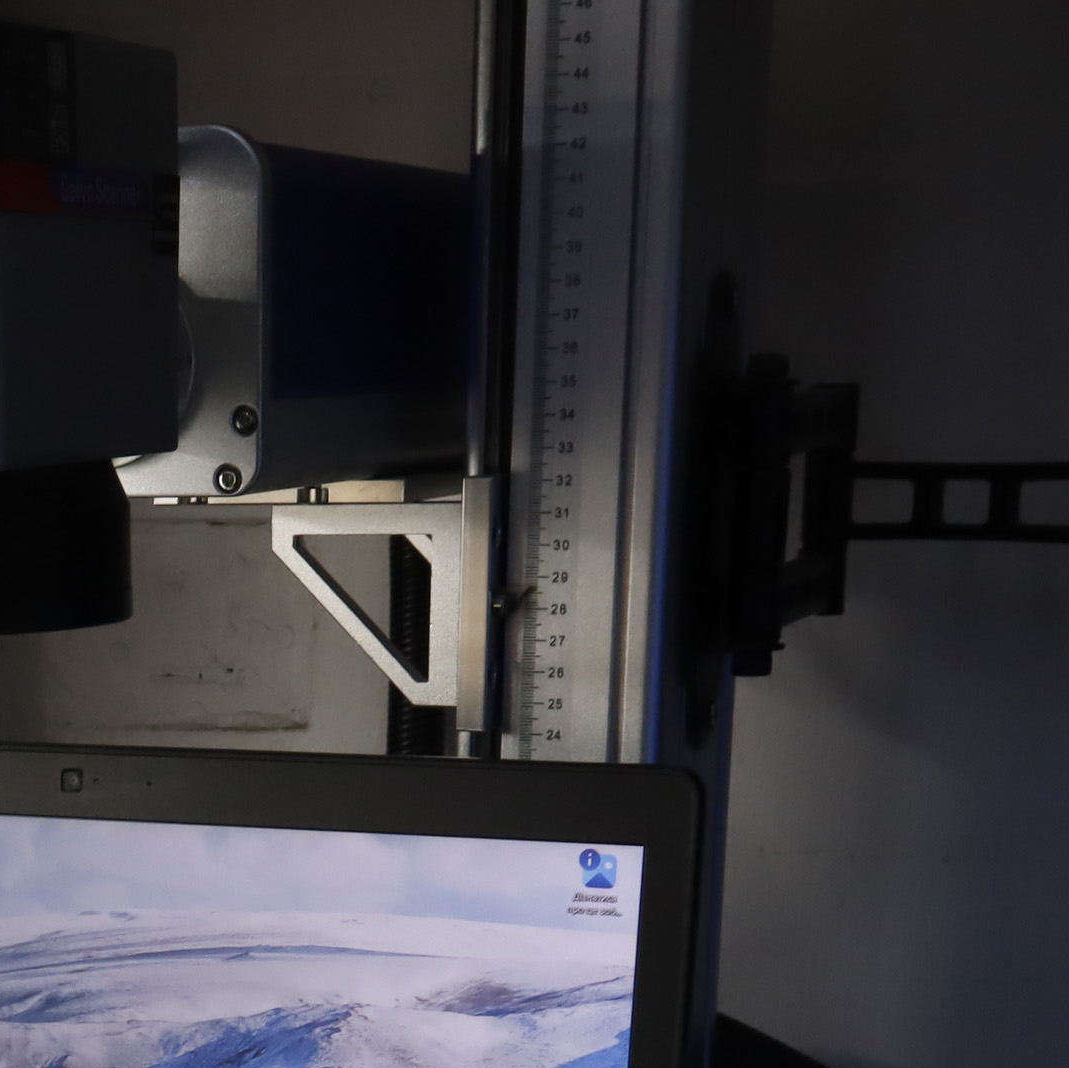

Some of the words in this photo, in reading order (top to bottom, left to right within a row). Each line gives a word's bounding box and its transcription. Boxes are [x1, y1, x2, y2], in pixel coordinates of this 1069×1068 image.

[574, 31, 591, 45] 45
[572, 67, 589, 79] 44
[571, 102, 588, 114] 43
[569, 136, 587, 150] 42
[568, 172, 583, 184] 41
[60, 173, 94, 204] Galvo
[94, 175, 141, 208] Scanner
[566, 206, 584, 218] 40
[564, 274, 581, 287] 38
[562, 308, 579, 320] 37
[561, 341, 578, 354] 36
[560, 375, 577, 388] 35
[559, 408, 575, 421] 34
[558, 441, 574, 453] 33
[555, 474, 573, 486] 32
[554, 507, 569, 518] 31
[552, 539, 569, 551] 30
[551, 571, 568, 583] 29
[550, 603, 567, 615] 28
[549, 634, 565, 647] 27
[547, 666, 564, 679] 26
[547, 698, 563, 710] 25
[545, 729, 561, 741] 24
